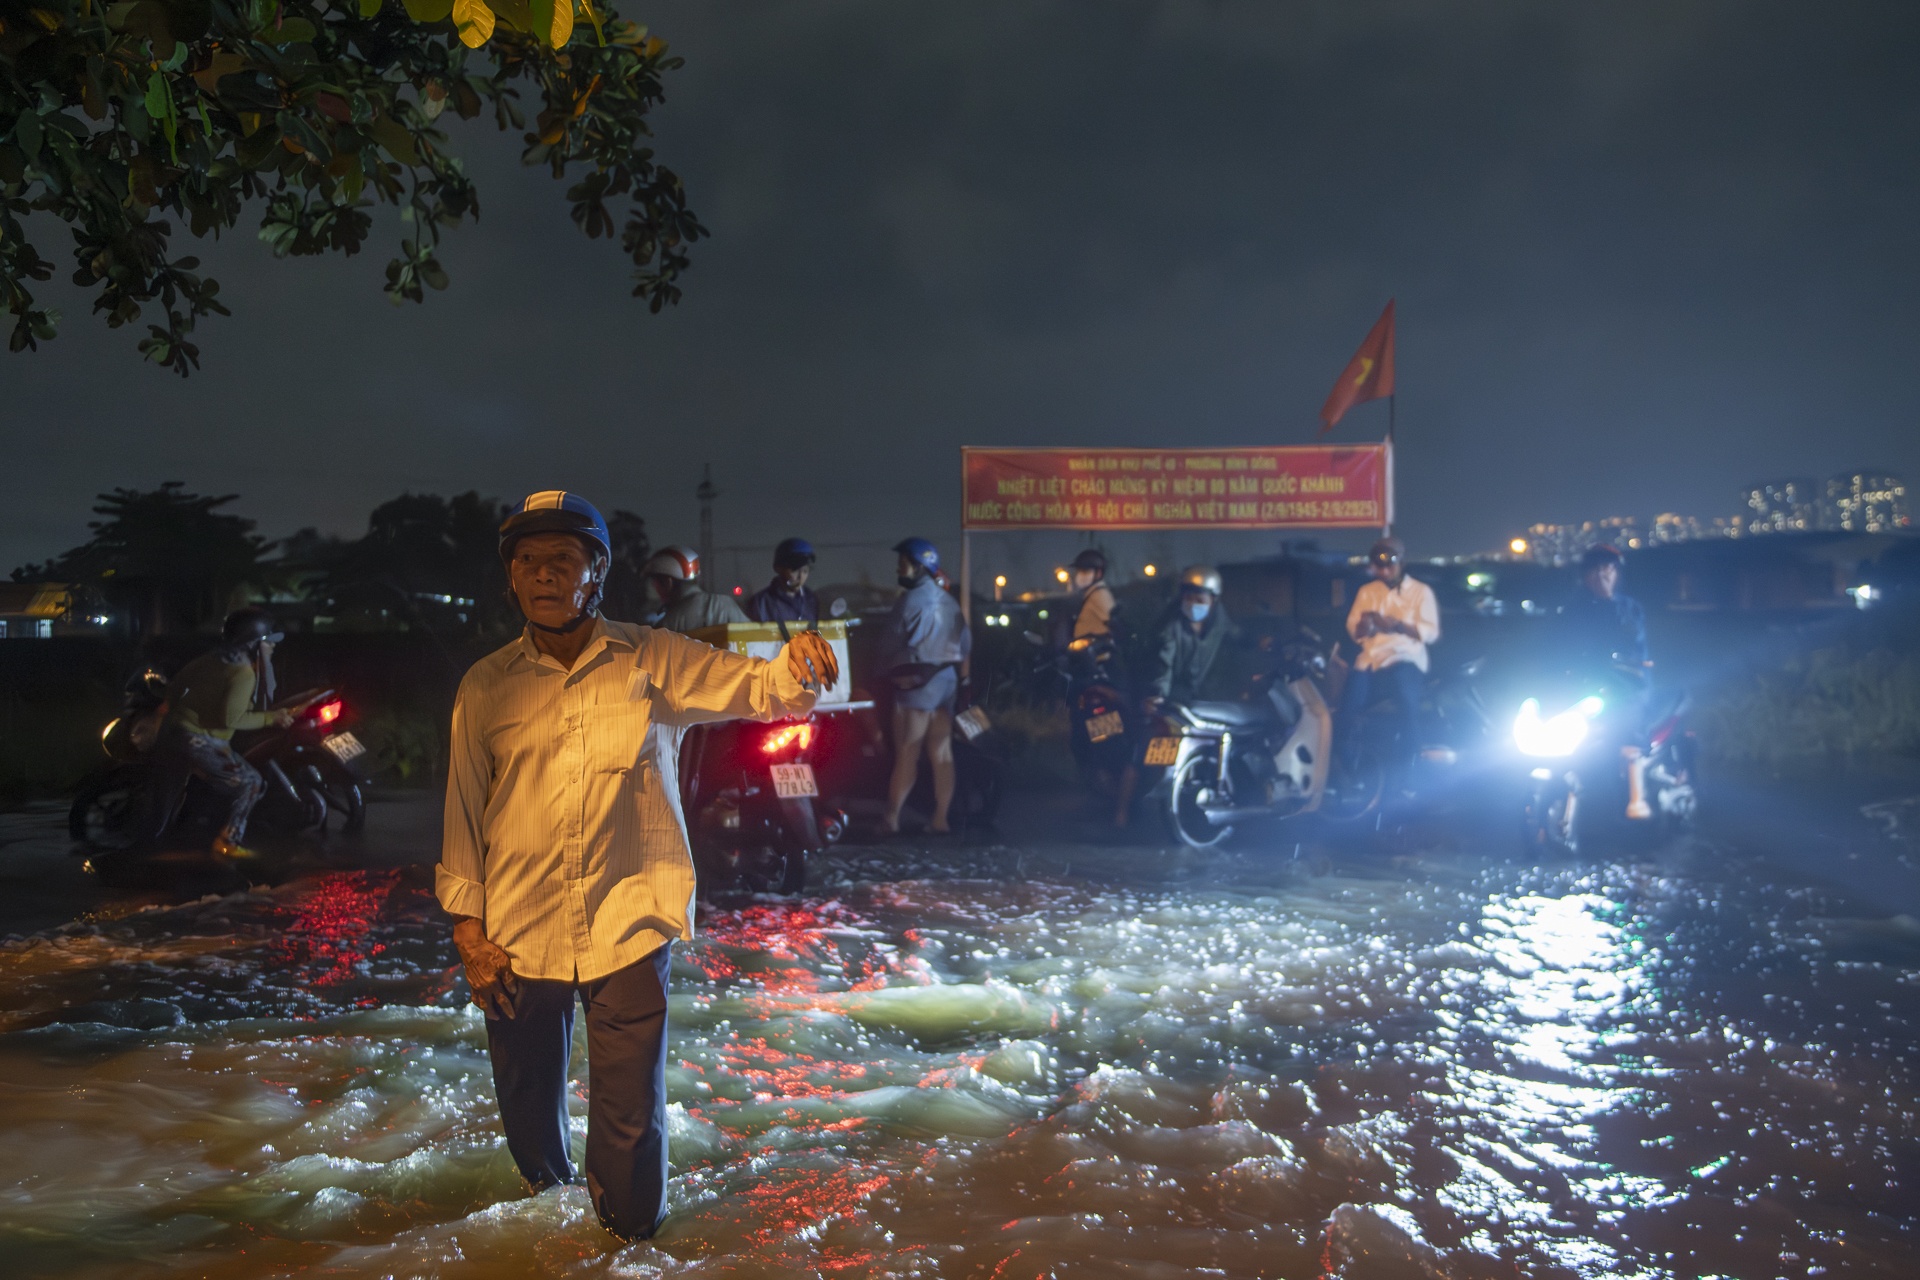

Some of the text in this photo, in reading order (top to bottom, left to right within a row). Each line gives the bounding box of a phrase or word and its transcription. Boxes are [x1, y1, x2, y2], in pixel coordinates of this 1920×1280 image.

[997, 475, 1035, 497] NHIỆT
[1039, 475, 1067, 497] LIỆT
[1071, 475, 1106, 496] CHÀO
[1109, 474, 1147, 496] MỪNG
[1151, 473, 1168, 495] KỶ
[1173, 475, 1207, 496] NIỆM
[1229, 474, 1259, 494] NĂM
[1262, 472, 1297, 495] QUỐC
[1300, 473, 1345, 494] KHÁNH
[968, 500, 1003, 520] NƯỚC
[1006, 500, 1042, 521] CỘNG
[1075, 499, 1093, 520] XÃ
[1096, 499, 1120, 522] HỘI
[1123, 499, 1149, 520] CHỦ
[1196, 499, 1226, 521] VIỆT
[1228, 502, 1258, 519] NAM
